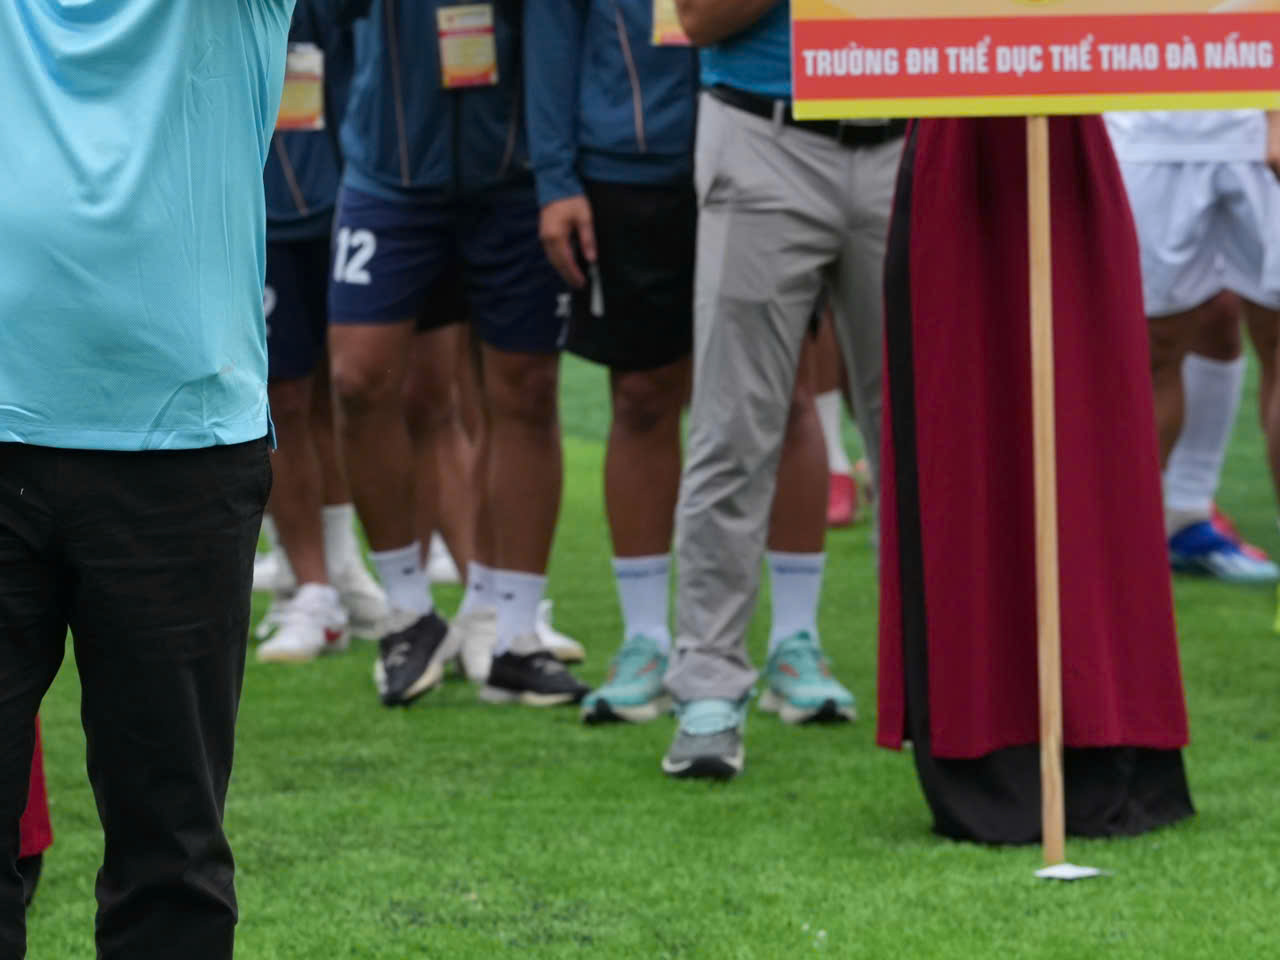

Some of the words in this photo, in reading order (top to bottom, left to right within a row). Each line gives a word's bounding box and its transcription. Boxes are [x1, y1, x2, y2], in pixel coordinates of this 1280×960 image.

[802, 40, 899, 77] TRƯỜNG
[906, 46, 939, 75] ĐH
[996, 44, 1043, 77] DỤC
[1098, 42, 1159, 72] THAO
[1165, 34, 1198, 71] ĐÀ
[333, 227, 377, 285] 12
